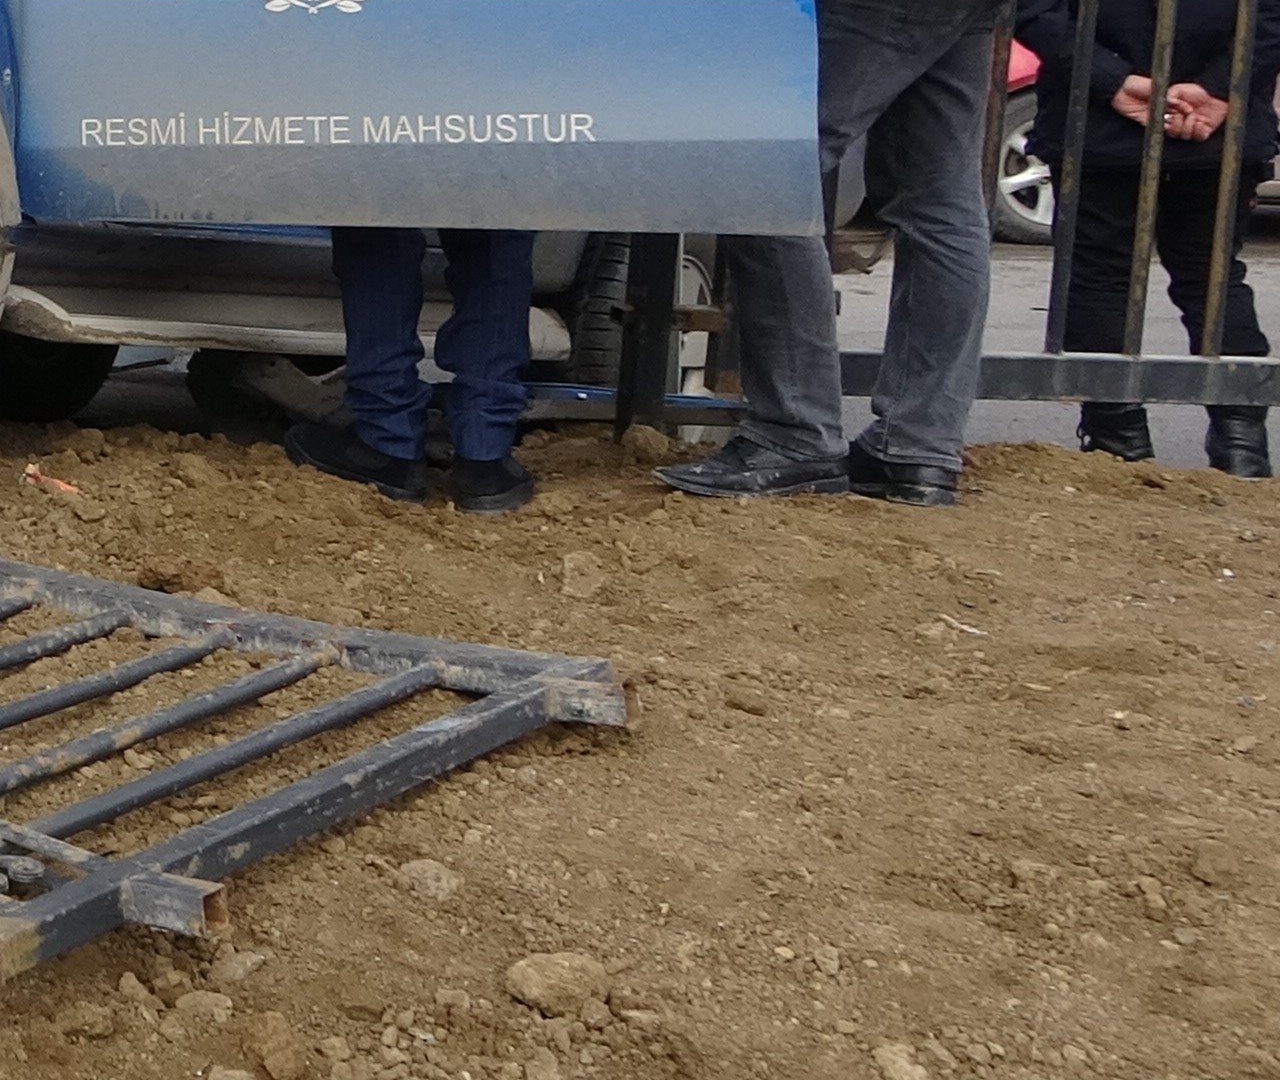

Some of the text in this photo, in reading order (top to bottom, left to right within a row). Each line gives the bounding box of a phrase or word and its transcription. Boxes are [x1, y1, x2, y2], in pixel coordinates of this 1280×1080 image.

[81, 111, 597, 146] RESMİ HİZMETE MAHSUSTUR
